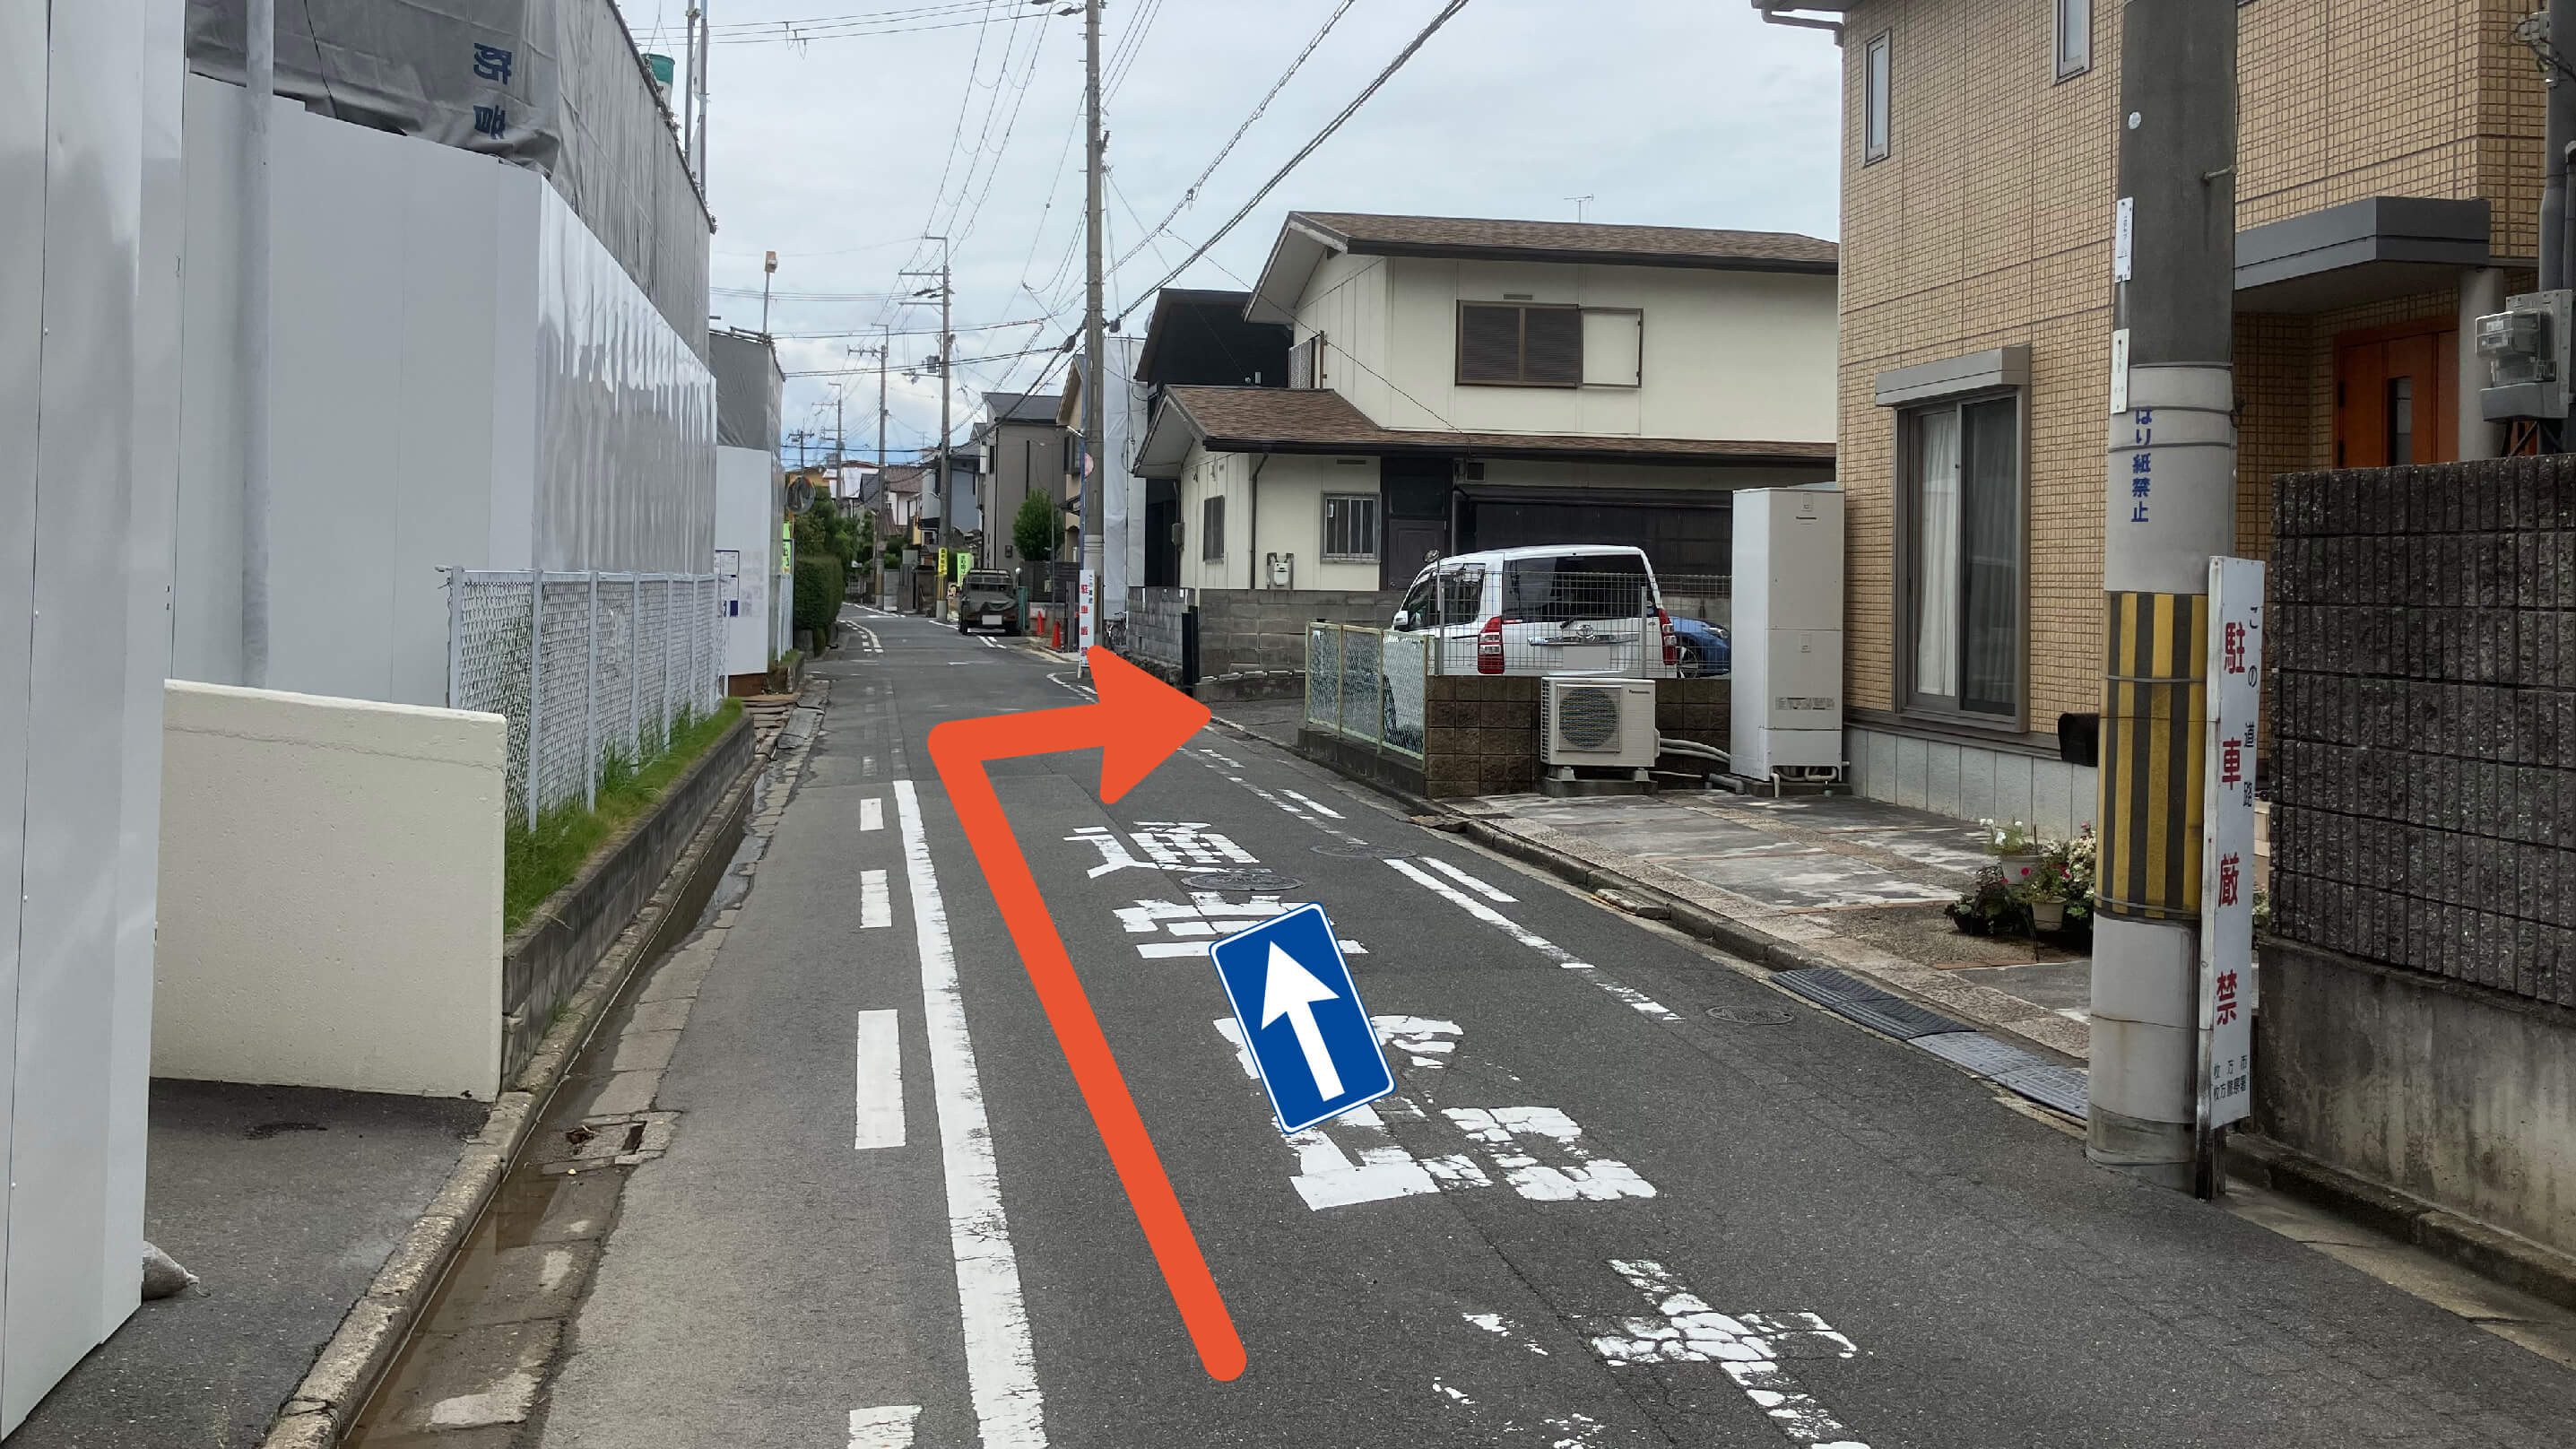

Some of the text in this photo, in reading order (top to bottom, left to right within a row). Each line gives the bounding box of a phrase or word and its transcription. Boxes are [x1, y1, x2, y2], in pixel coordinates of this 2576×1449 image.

[473, 42, 512, 140] 防音
[2130, 408, 2153, 523] はり紙禁止
[2242, 606, 2259, 808] この道路
[2216, 621, 2246, 1026] 駐車厳禁
